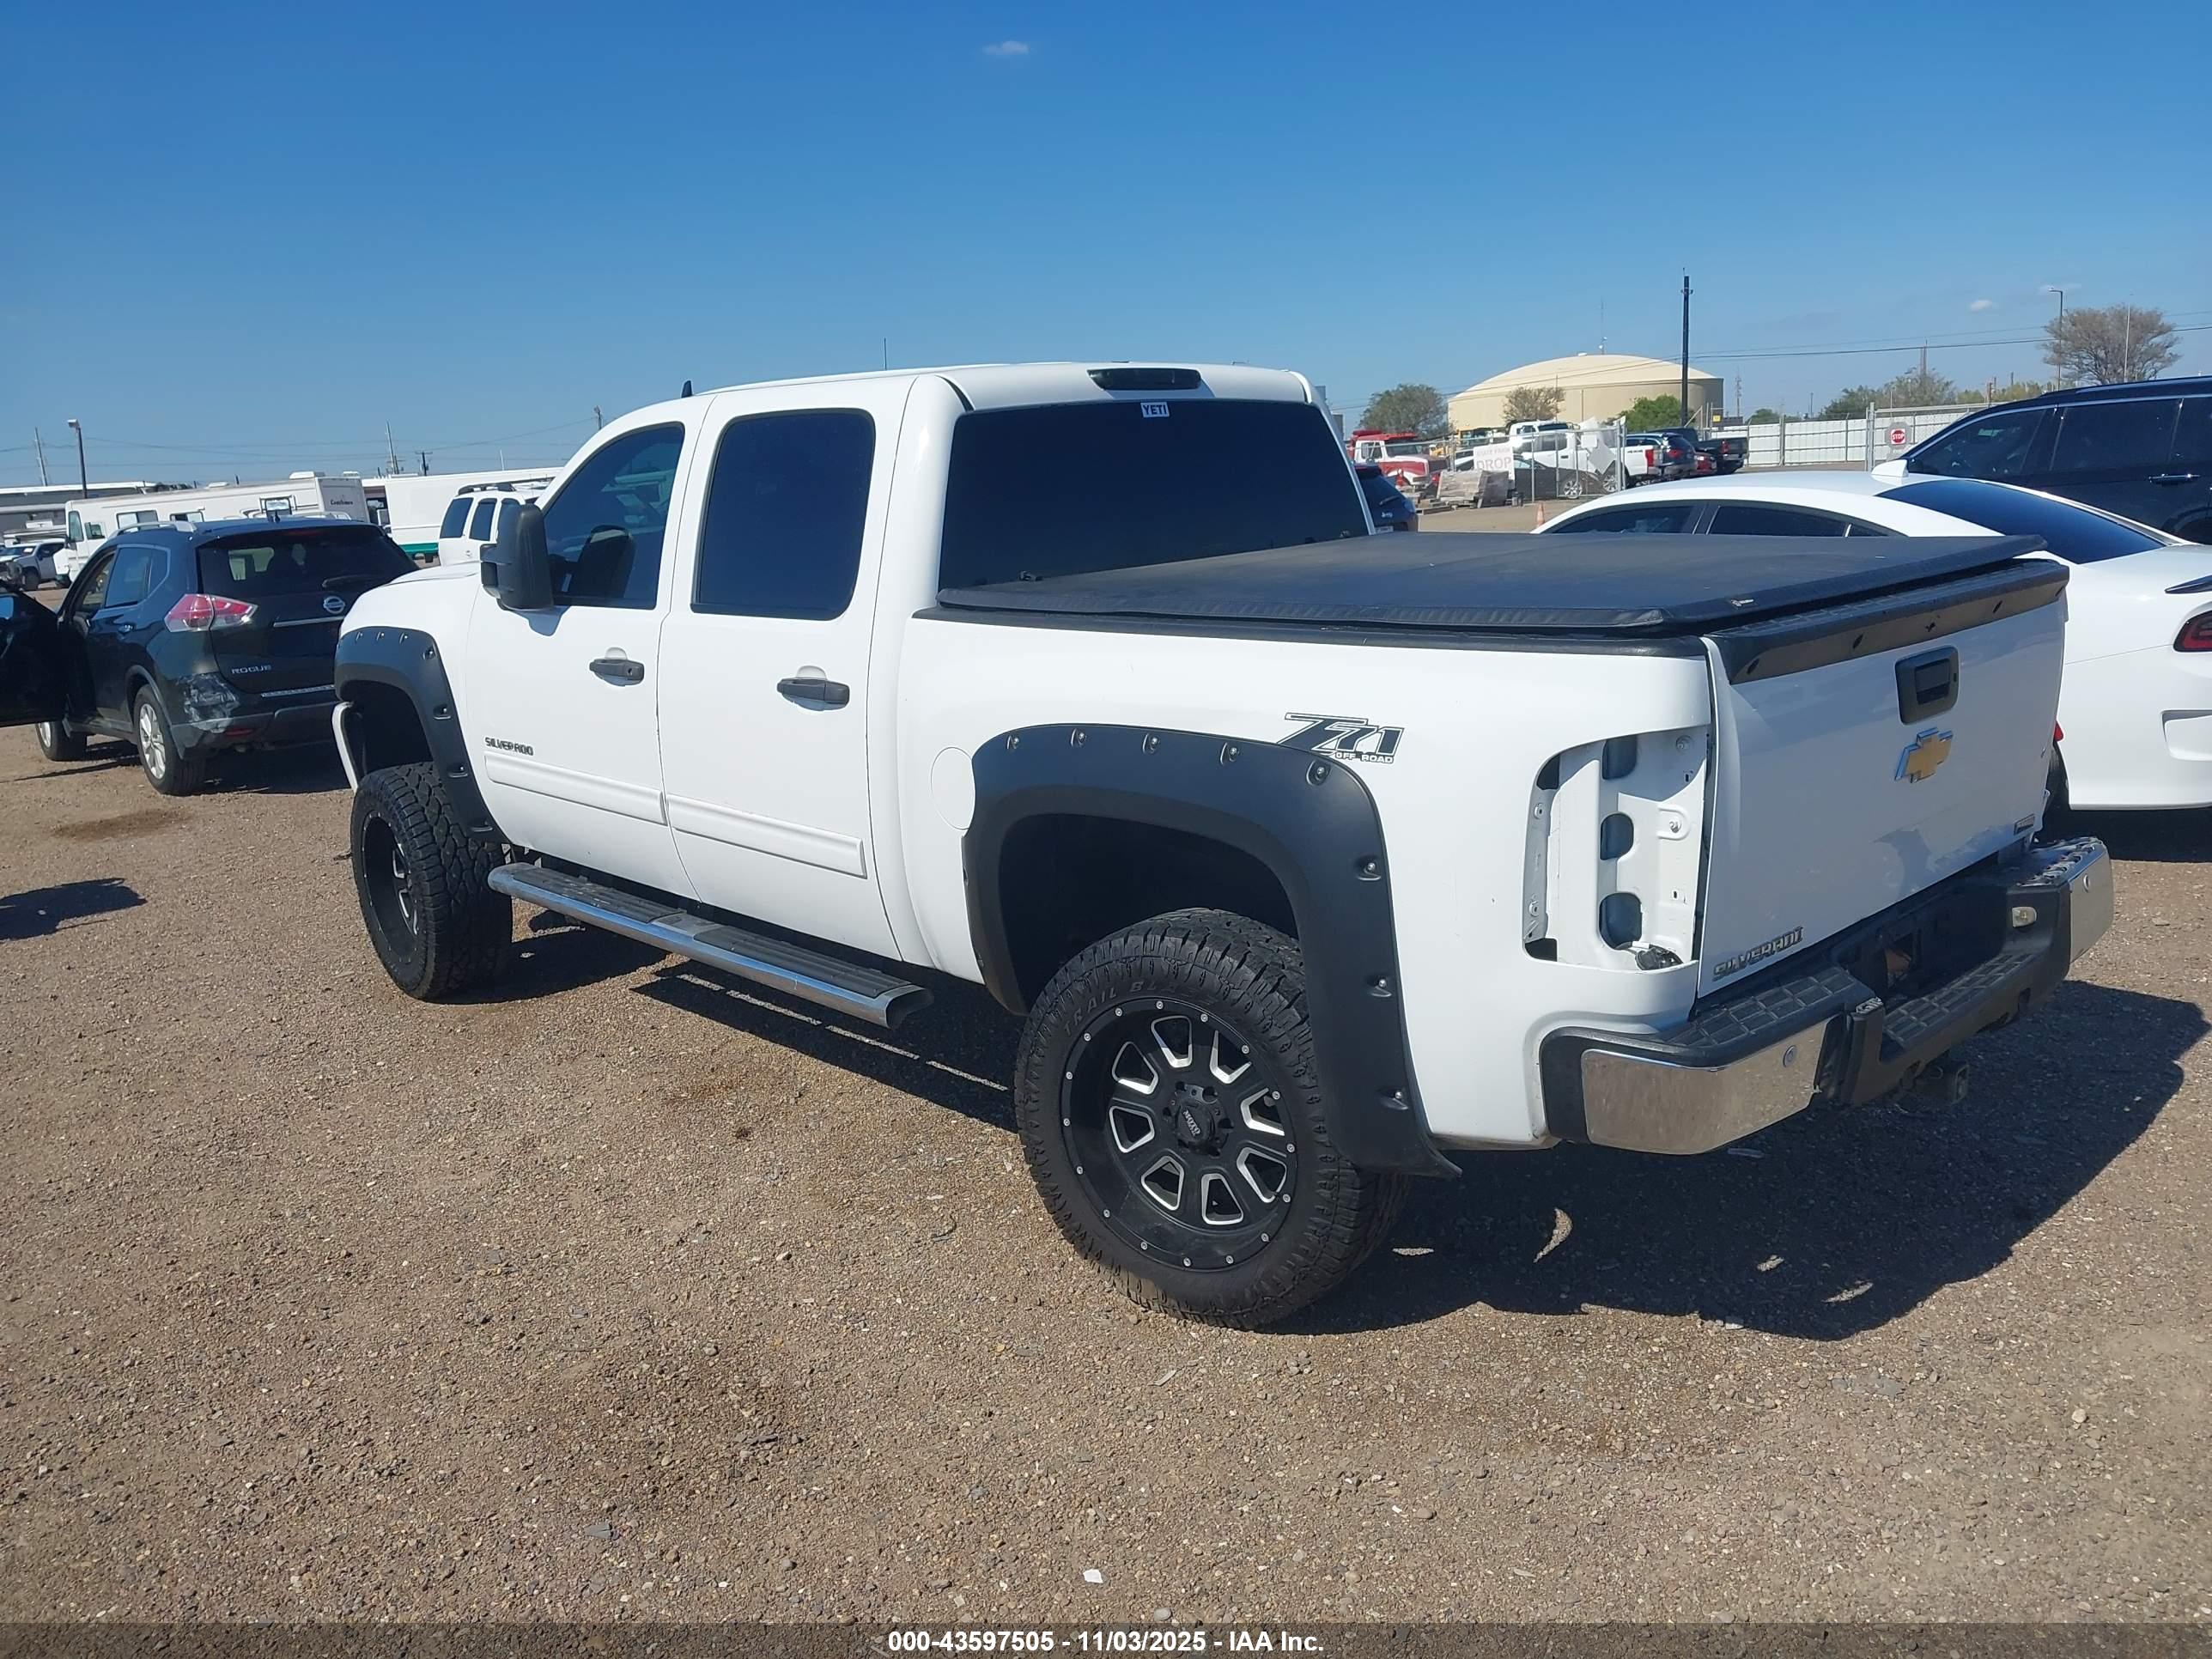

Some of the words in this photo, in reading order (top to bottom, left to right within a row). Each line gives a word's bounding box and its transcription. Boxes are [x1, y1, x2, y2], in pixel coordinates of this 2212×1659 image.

[1142, 404, 1167, 416] YETI
[1477, 457, 1511, 471] DROP
[231, 665, 272, 674] ROGUE
[1276, 712, 1405, 757] Z71
[484, 737, 534, 756] SILVERADO
[1362, 753, 1394, 763] ROAD
[1712, 926, 1804, 981] SILVERADO
[1065, 987, 1116, 1036] TRAIL
